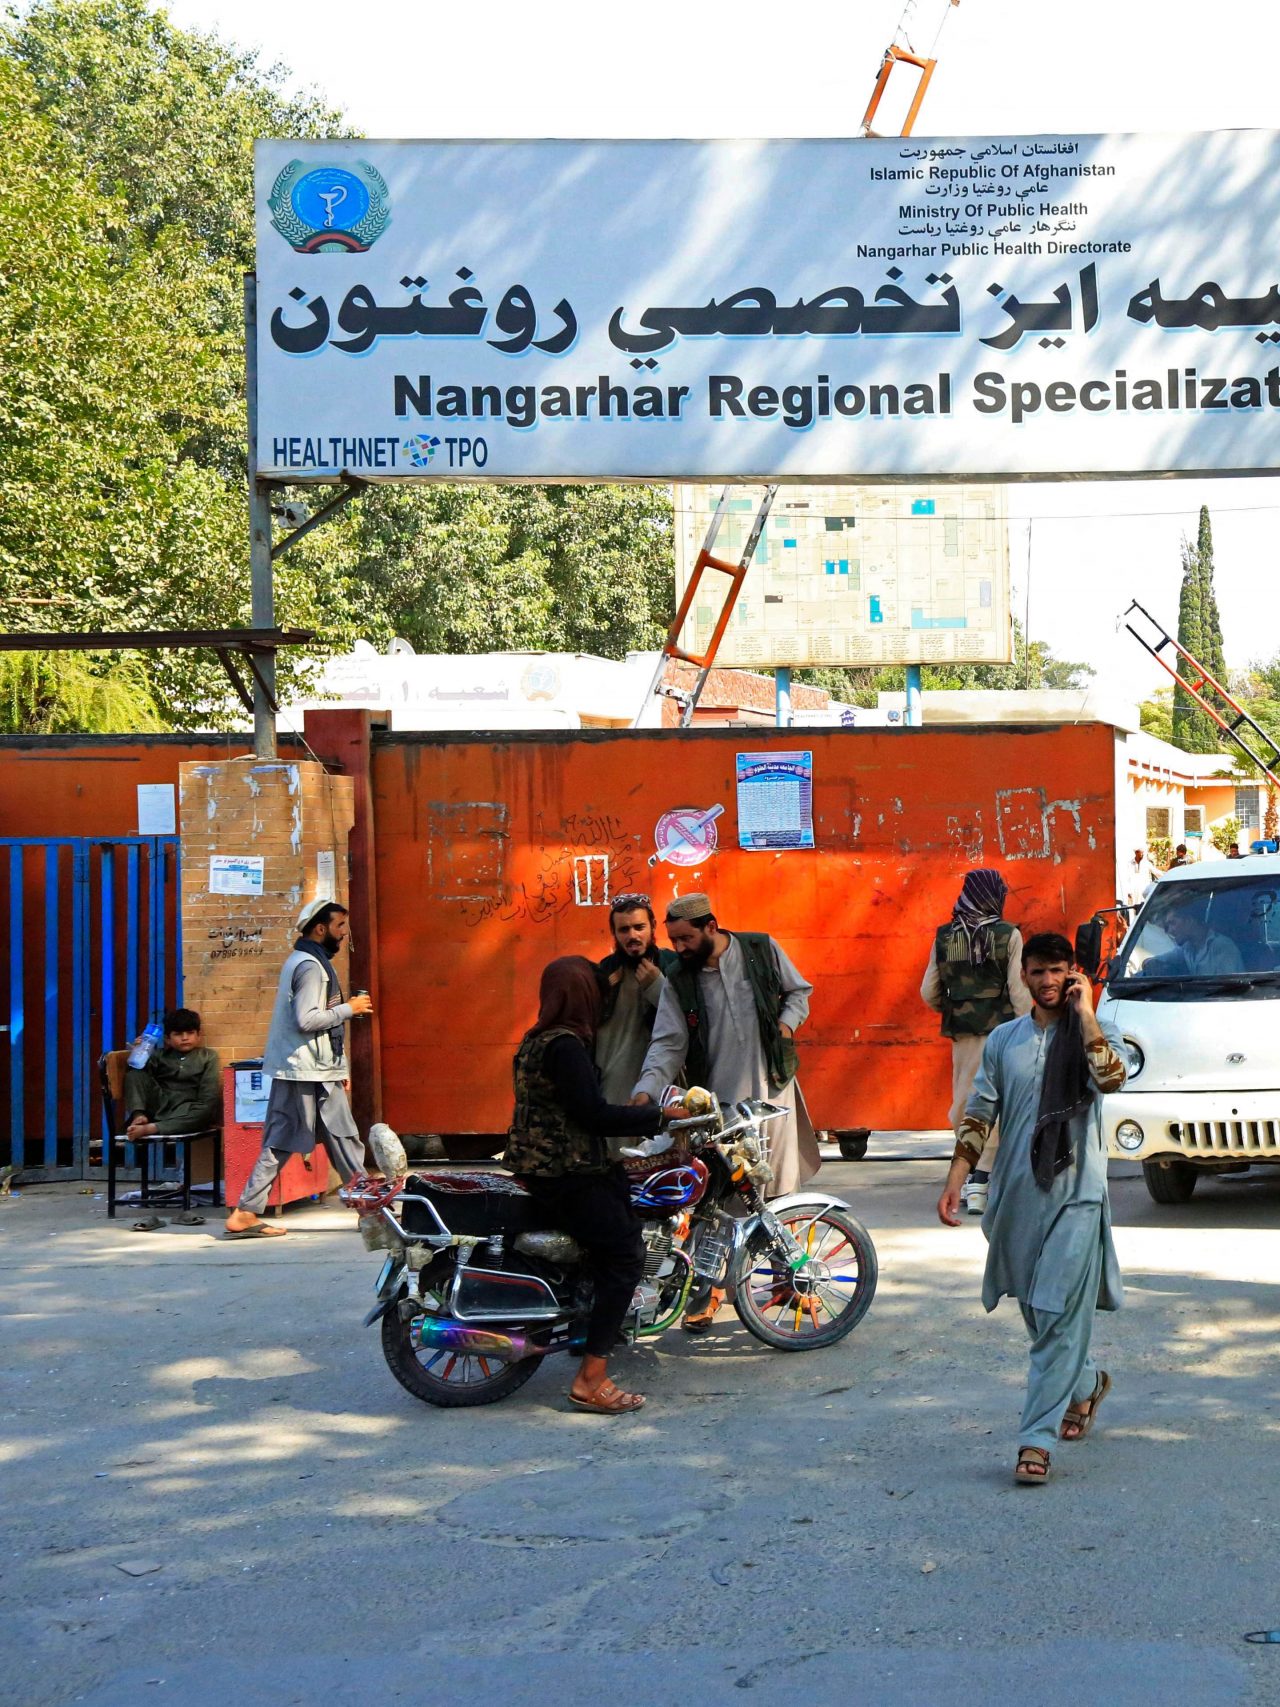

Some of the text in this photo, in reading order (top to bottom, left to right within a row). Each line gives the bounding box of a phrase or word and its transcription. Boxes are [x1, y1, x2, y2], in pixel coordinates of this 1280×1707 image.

[1021, 143, 1079, 157] افغانستان
[870, 163, 1116, 182] Islamic Republic Of Afghanistan
[925, 183, 969, 198] وزارت
[899, 202, 1089, 221] Ministry Of Public Health
[857, 239, 1132, 261] Nangarhar Public Health Directorate
[270, 266, 578, 354] روغتون
[394, 373, 690, 428] Nangarhar
[709, 372, 951, 430] Regional
[273, 437, 488, 468] HEALTHNET TPO
